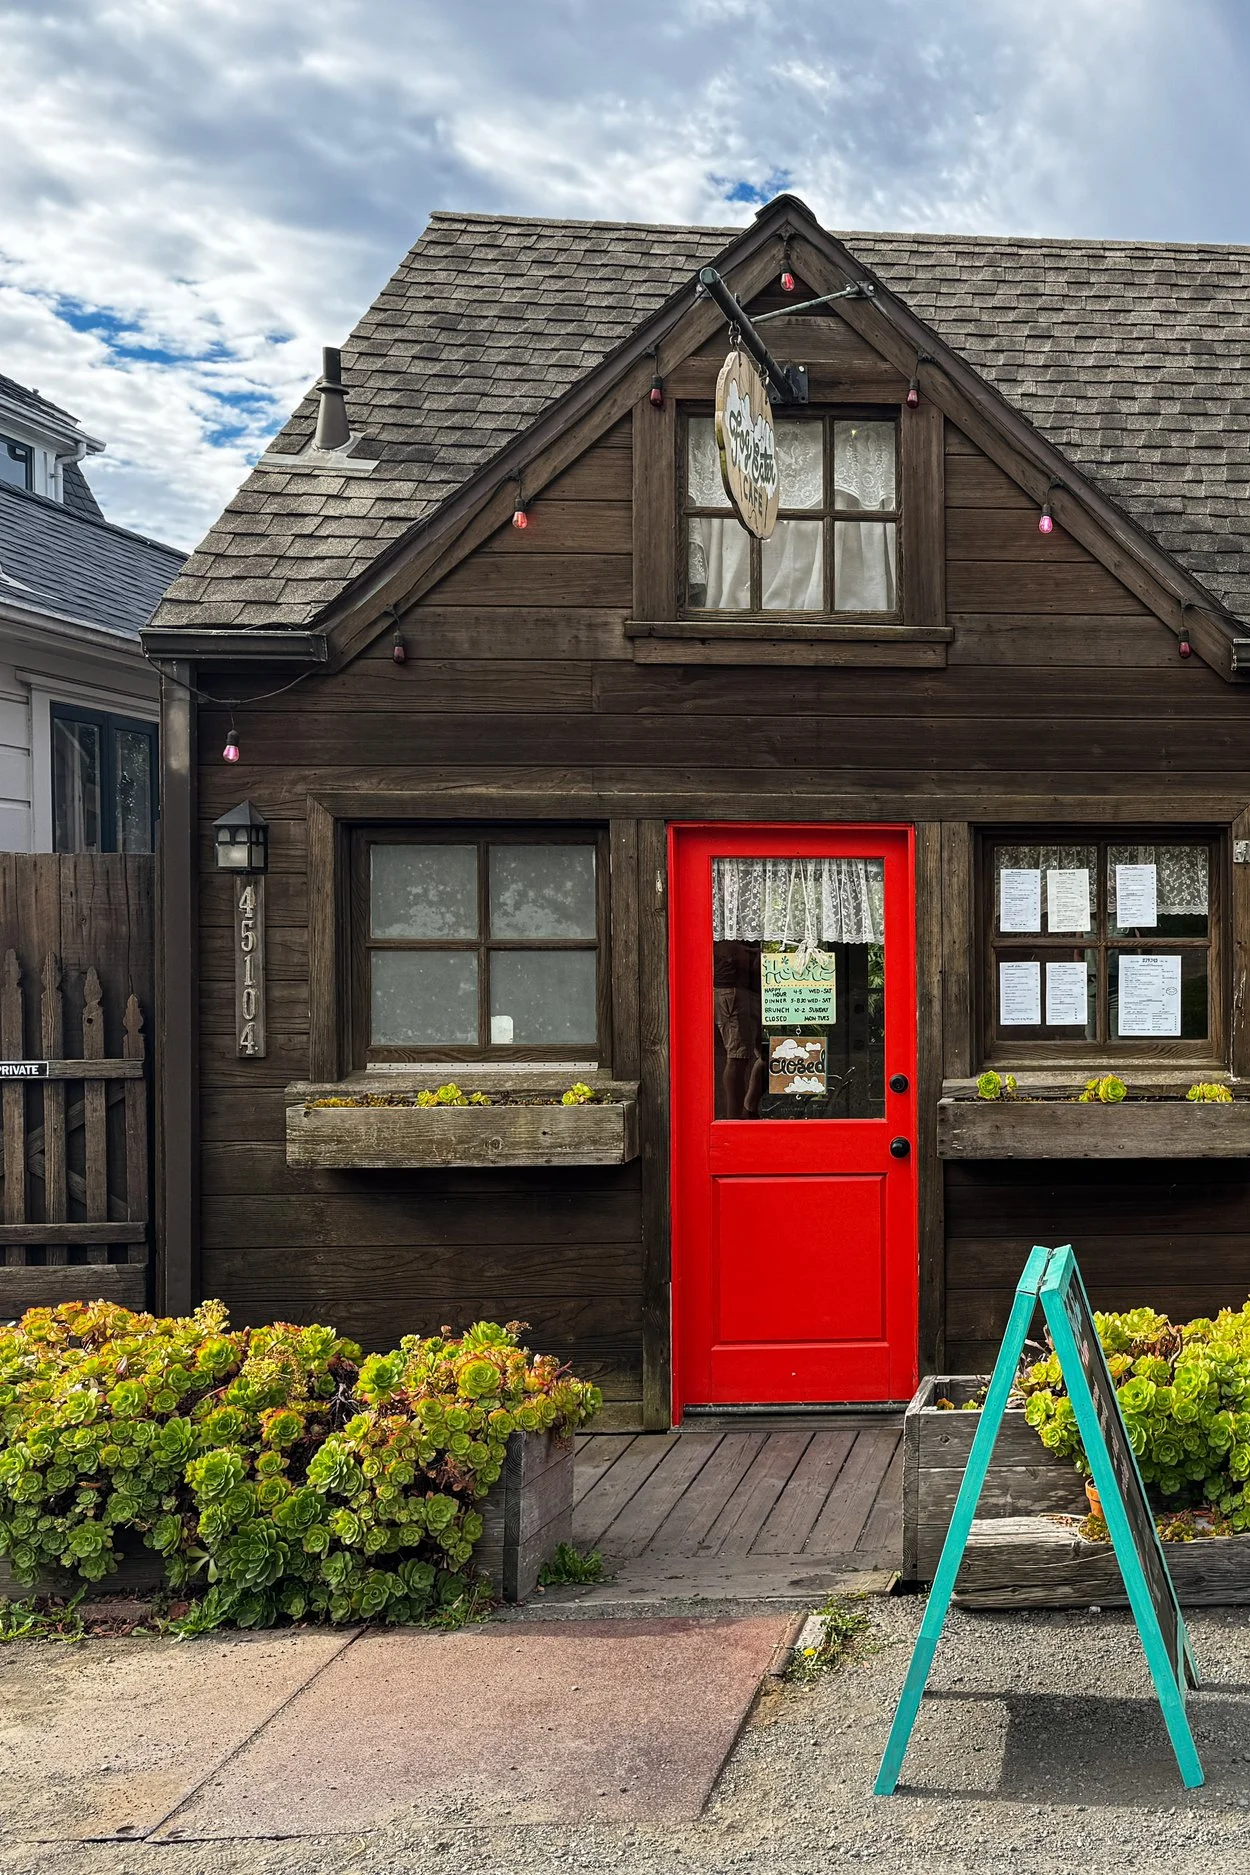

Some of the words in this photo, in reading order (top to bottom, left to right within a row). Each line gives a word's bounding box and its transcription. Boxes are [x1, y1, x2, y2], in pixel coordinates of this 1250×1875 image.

[729, 410, 753, 471] Fog
[751, 441, 777, 486] Eater
[743, 475, 763, 516] CAFE
[238, 885, 257, 1055] 45104
